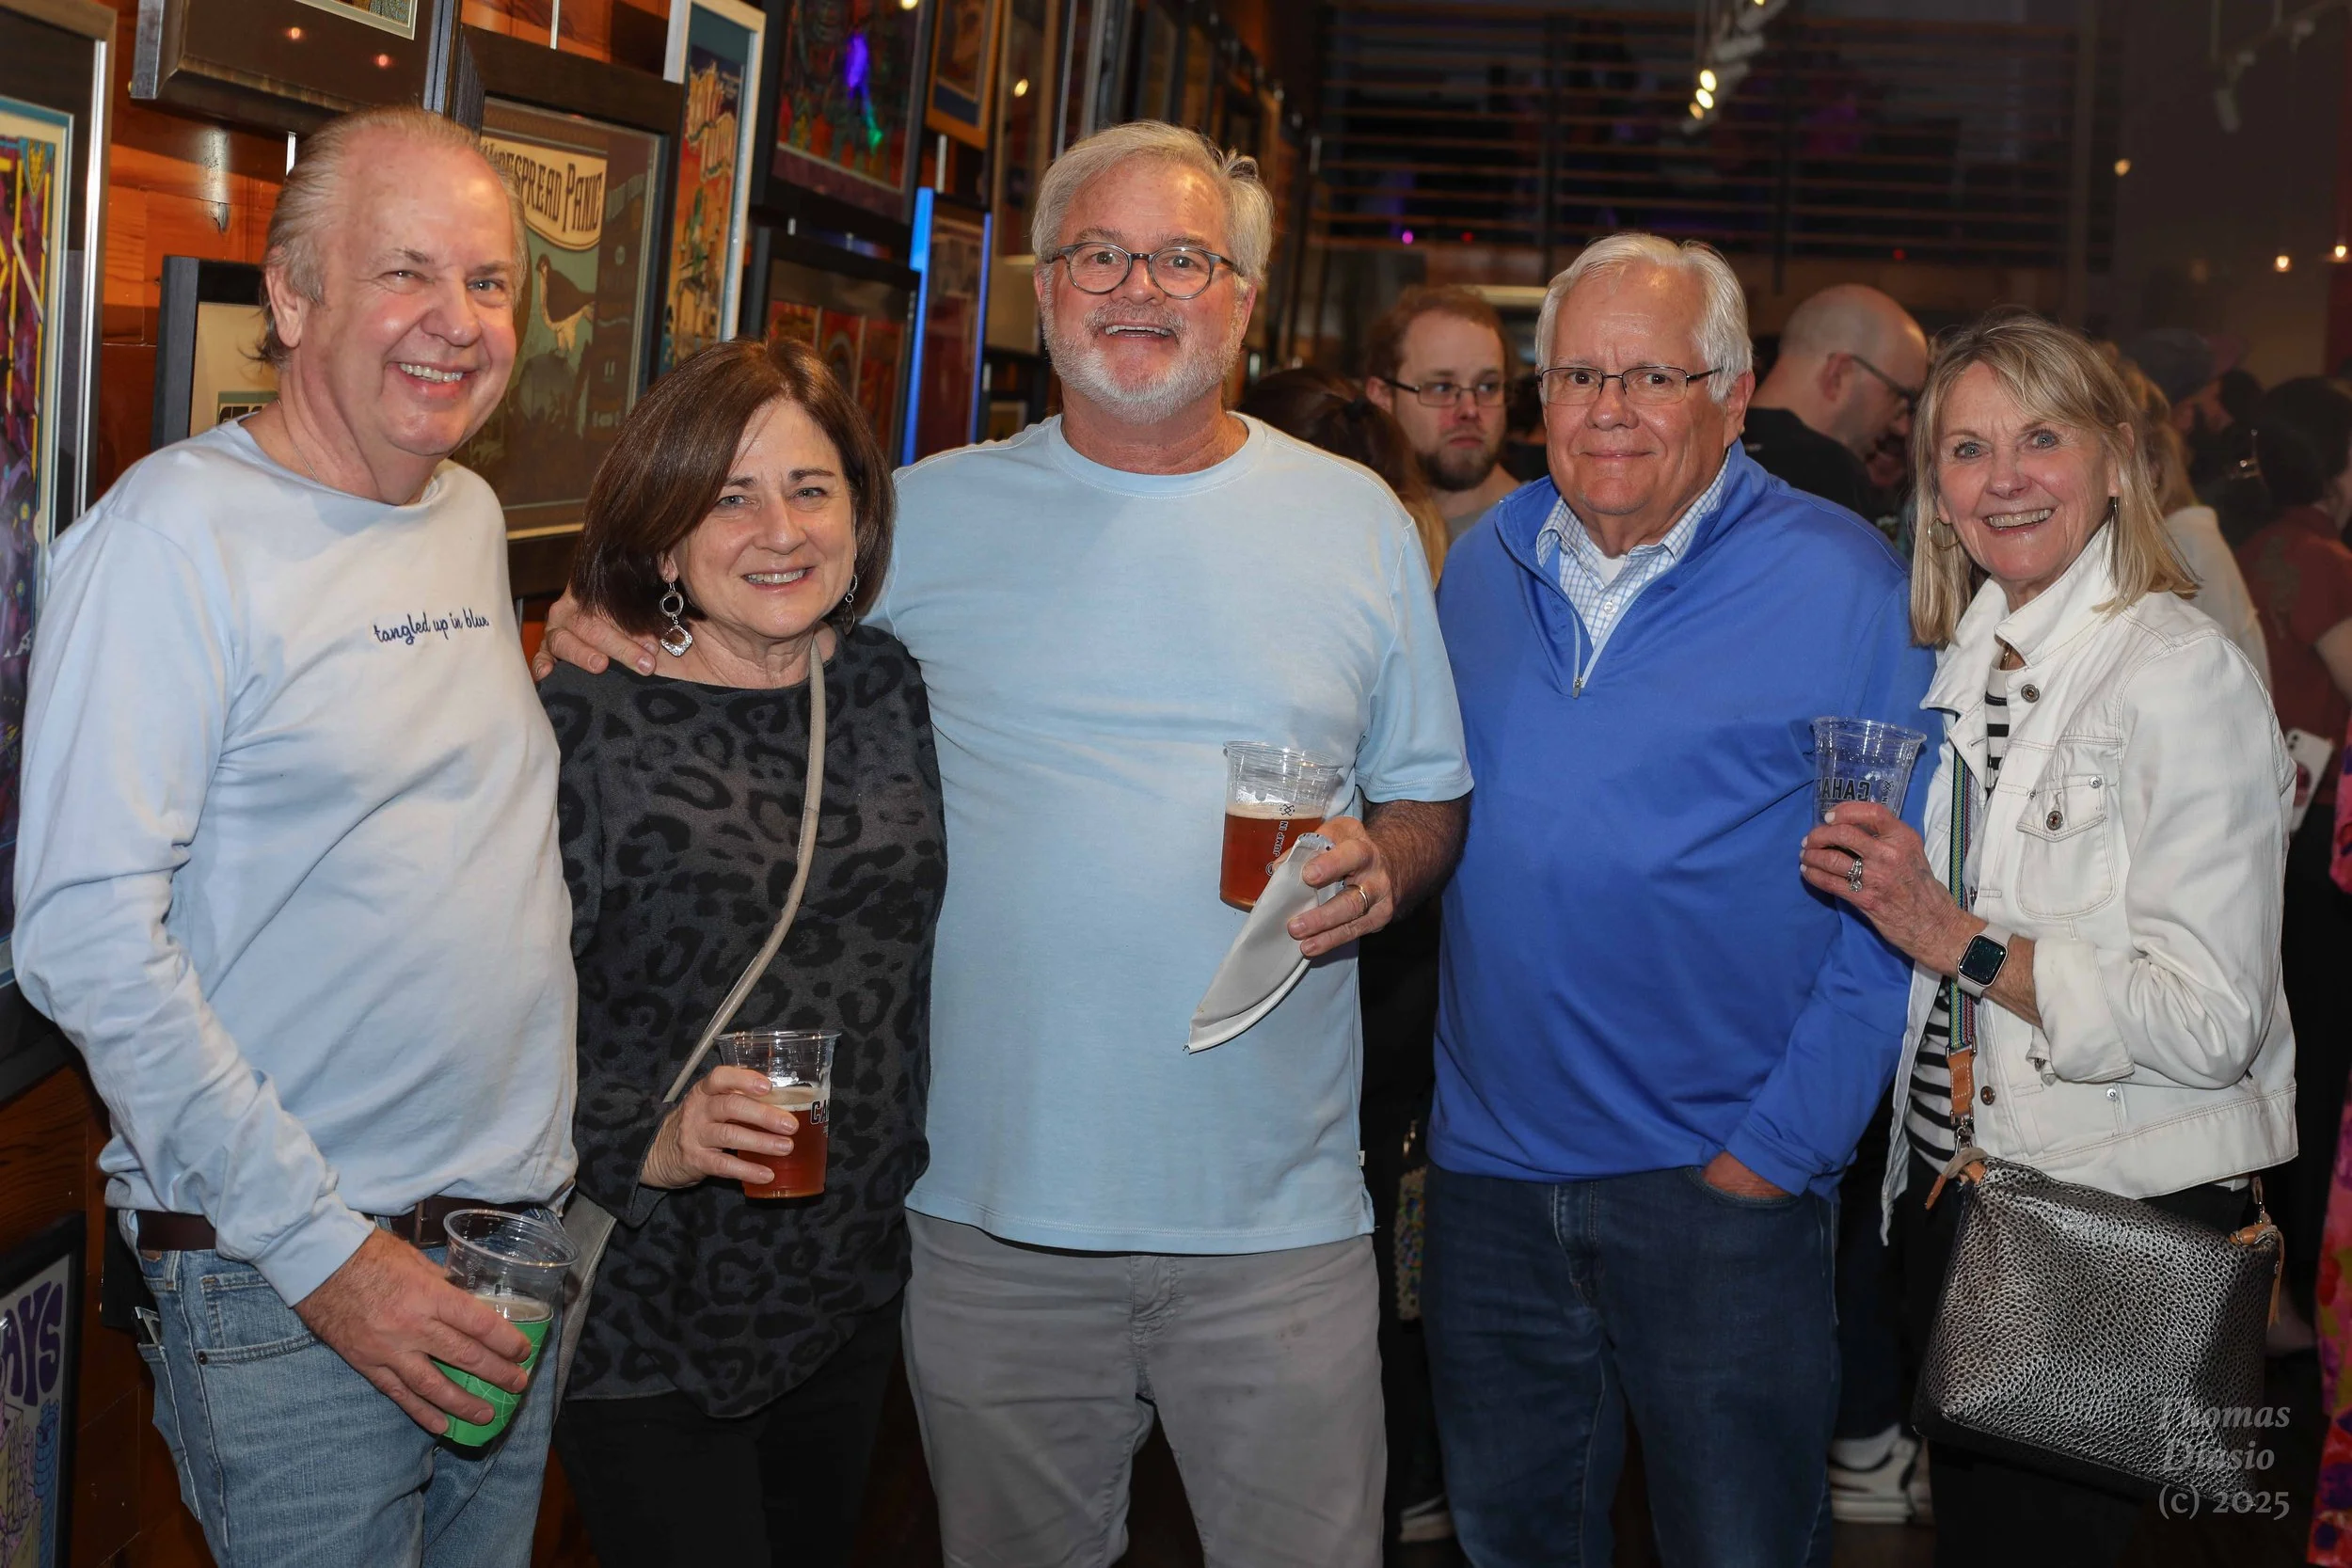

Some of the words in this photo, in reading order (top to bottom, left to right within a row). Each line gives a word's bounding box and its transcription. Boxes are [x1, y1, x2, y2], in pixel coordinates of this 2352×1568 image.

[373, 611, 431, 645] tangled
[433, 618, 449, 640] up
[449, 612, 463, 629] in
[463, 607, 489, 628] blue
[1273, 832, 1284, 857] JUMP
[1279, 820, 1289, 832] IN
